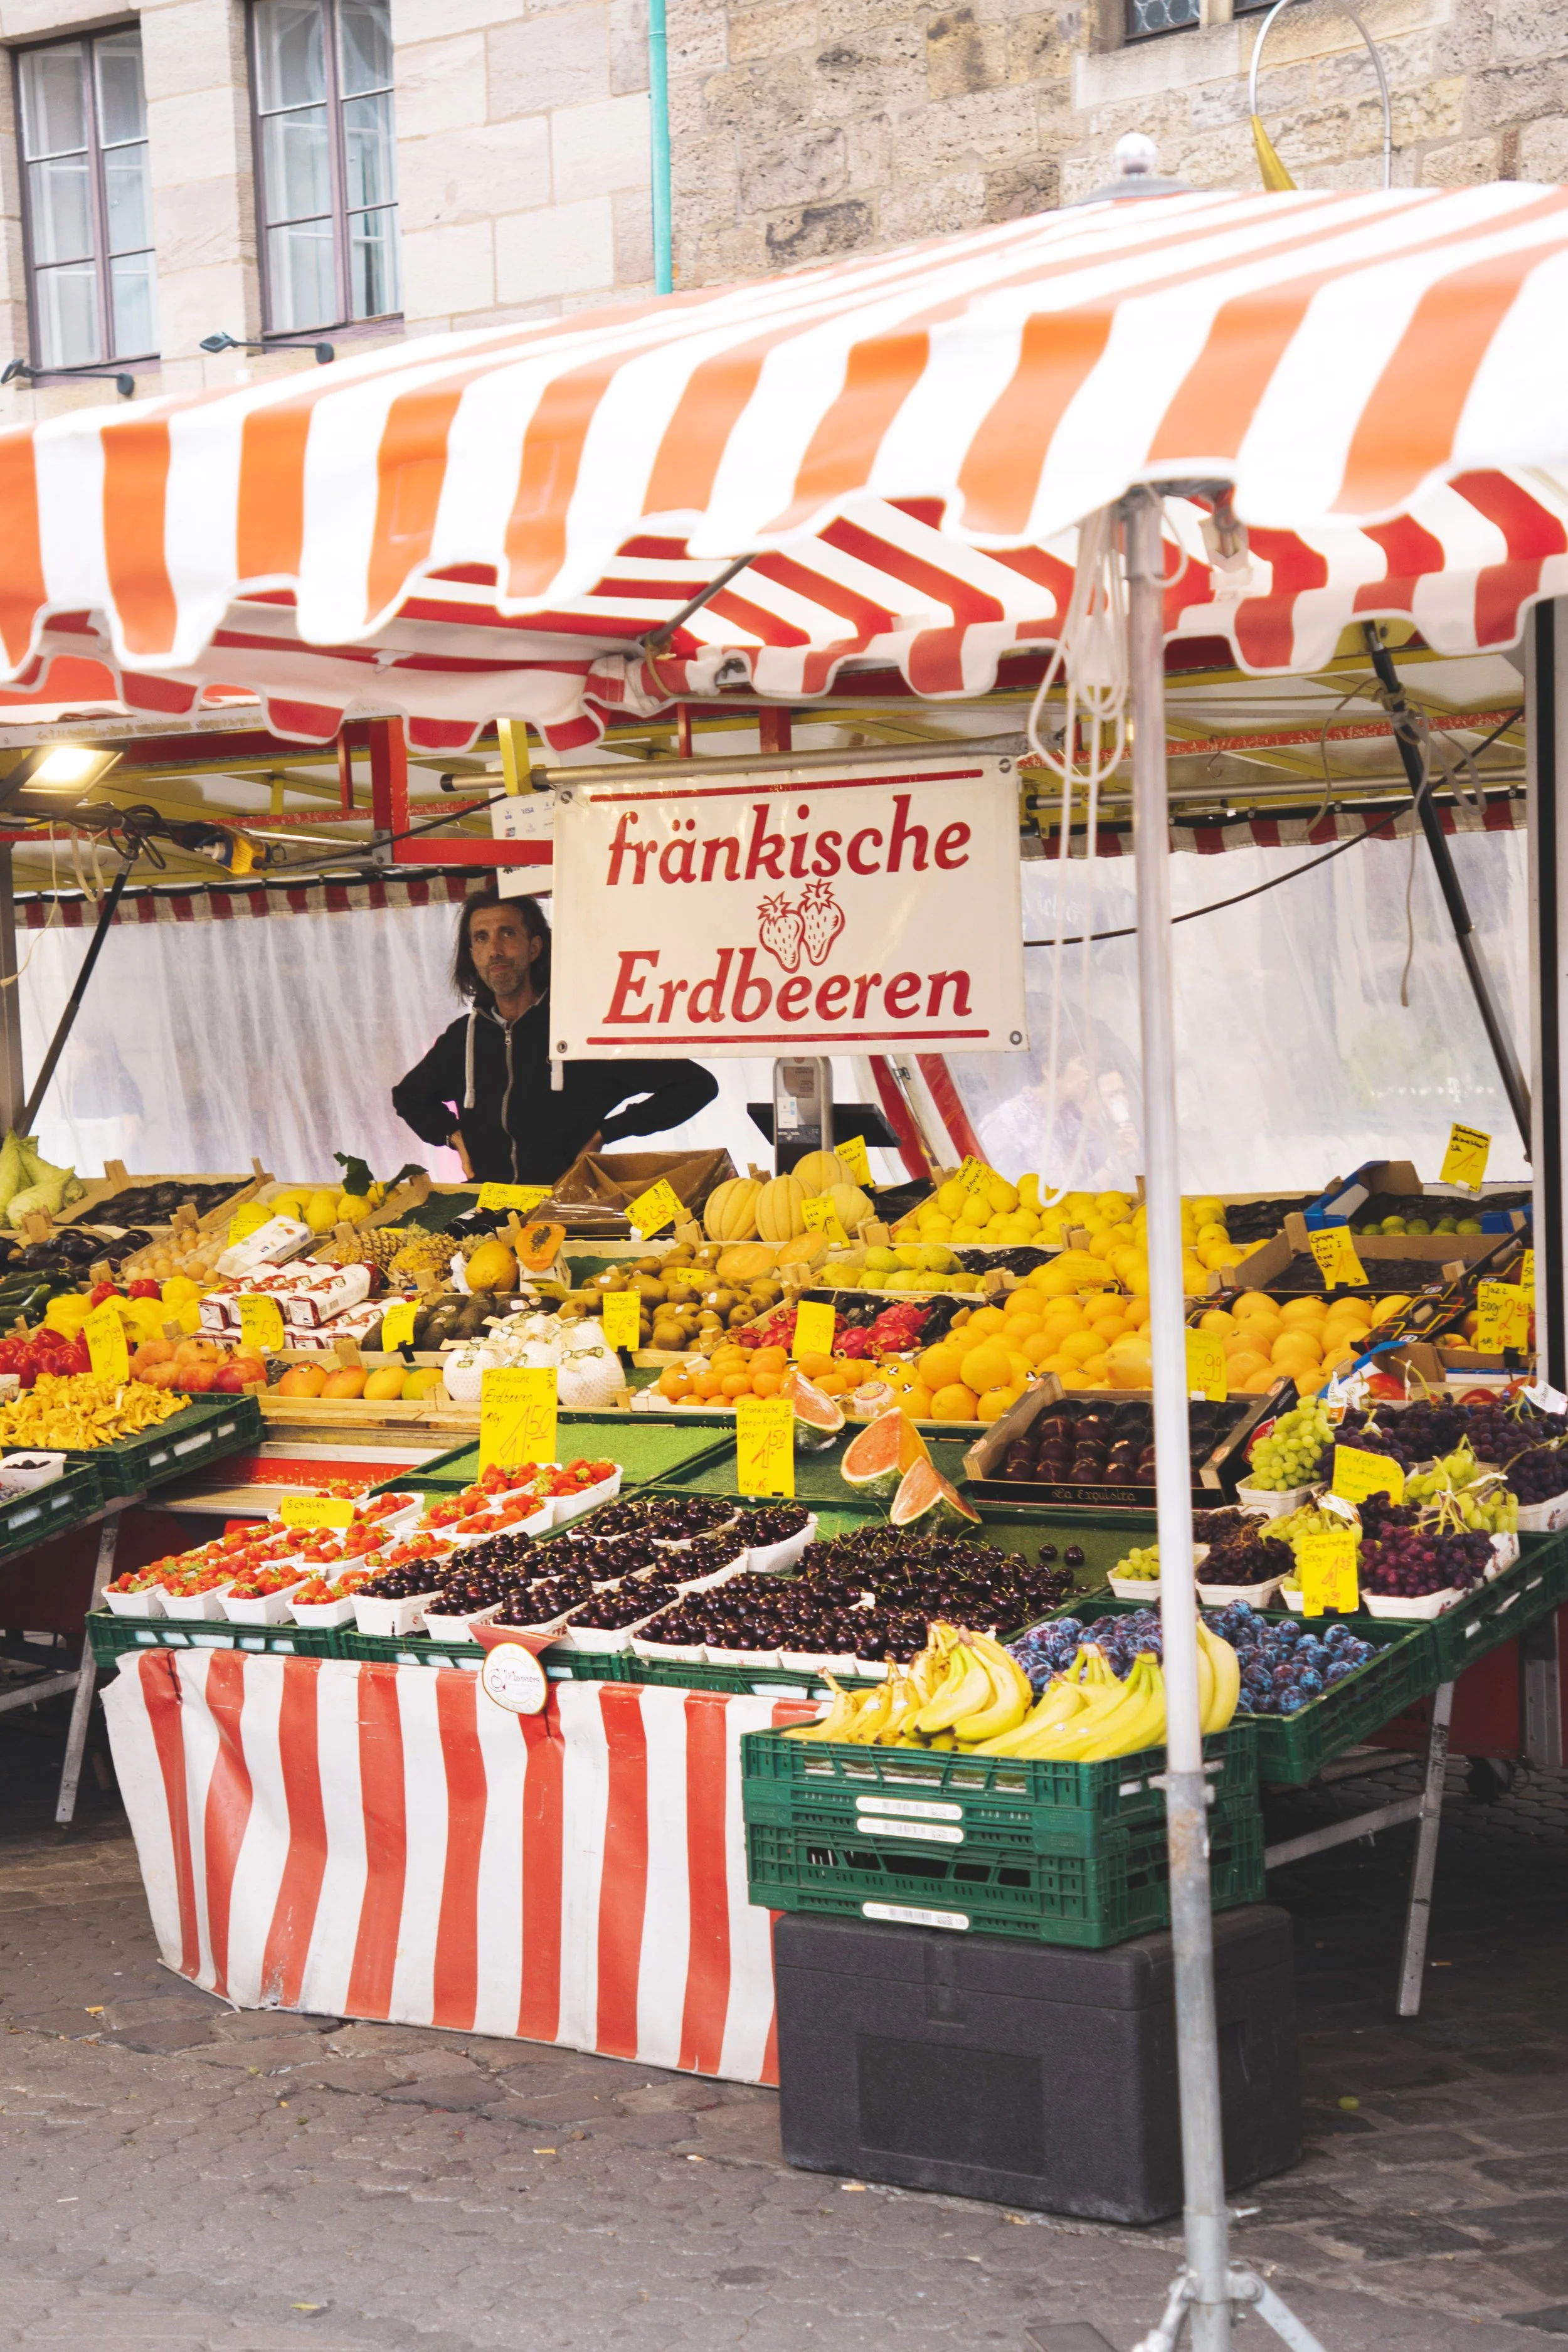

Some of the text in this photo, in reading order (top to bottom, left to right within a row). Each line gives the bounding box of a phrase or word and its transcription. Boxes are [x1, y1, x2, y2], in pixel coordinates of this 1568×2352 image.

[606, 794, 970, 886] fränkische
[603, 947, 972, 1024] Erdbeeren
[484, 1184, 509, 1197] Bitte
[1310, 1233, 1339, 1244] Grape-
[1480, 1284, 1508, 1298] Jazz
[484, 1388, 533, 1404] Erdbeeren
[285, 1499, 326, 1511] Schalen
